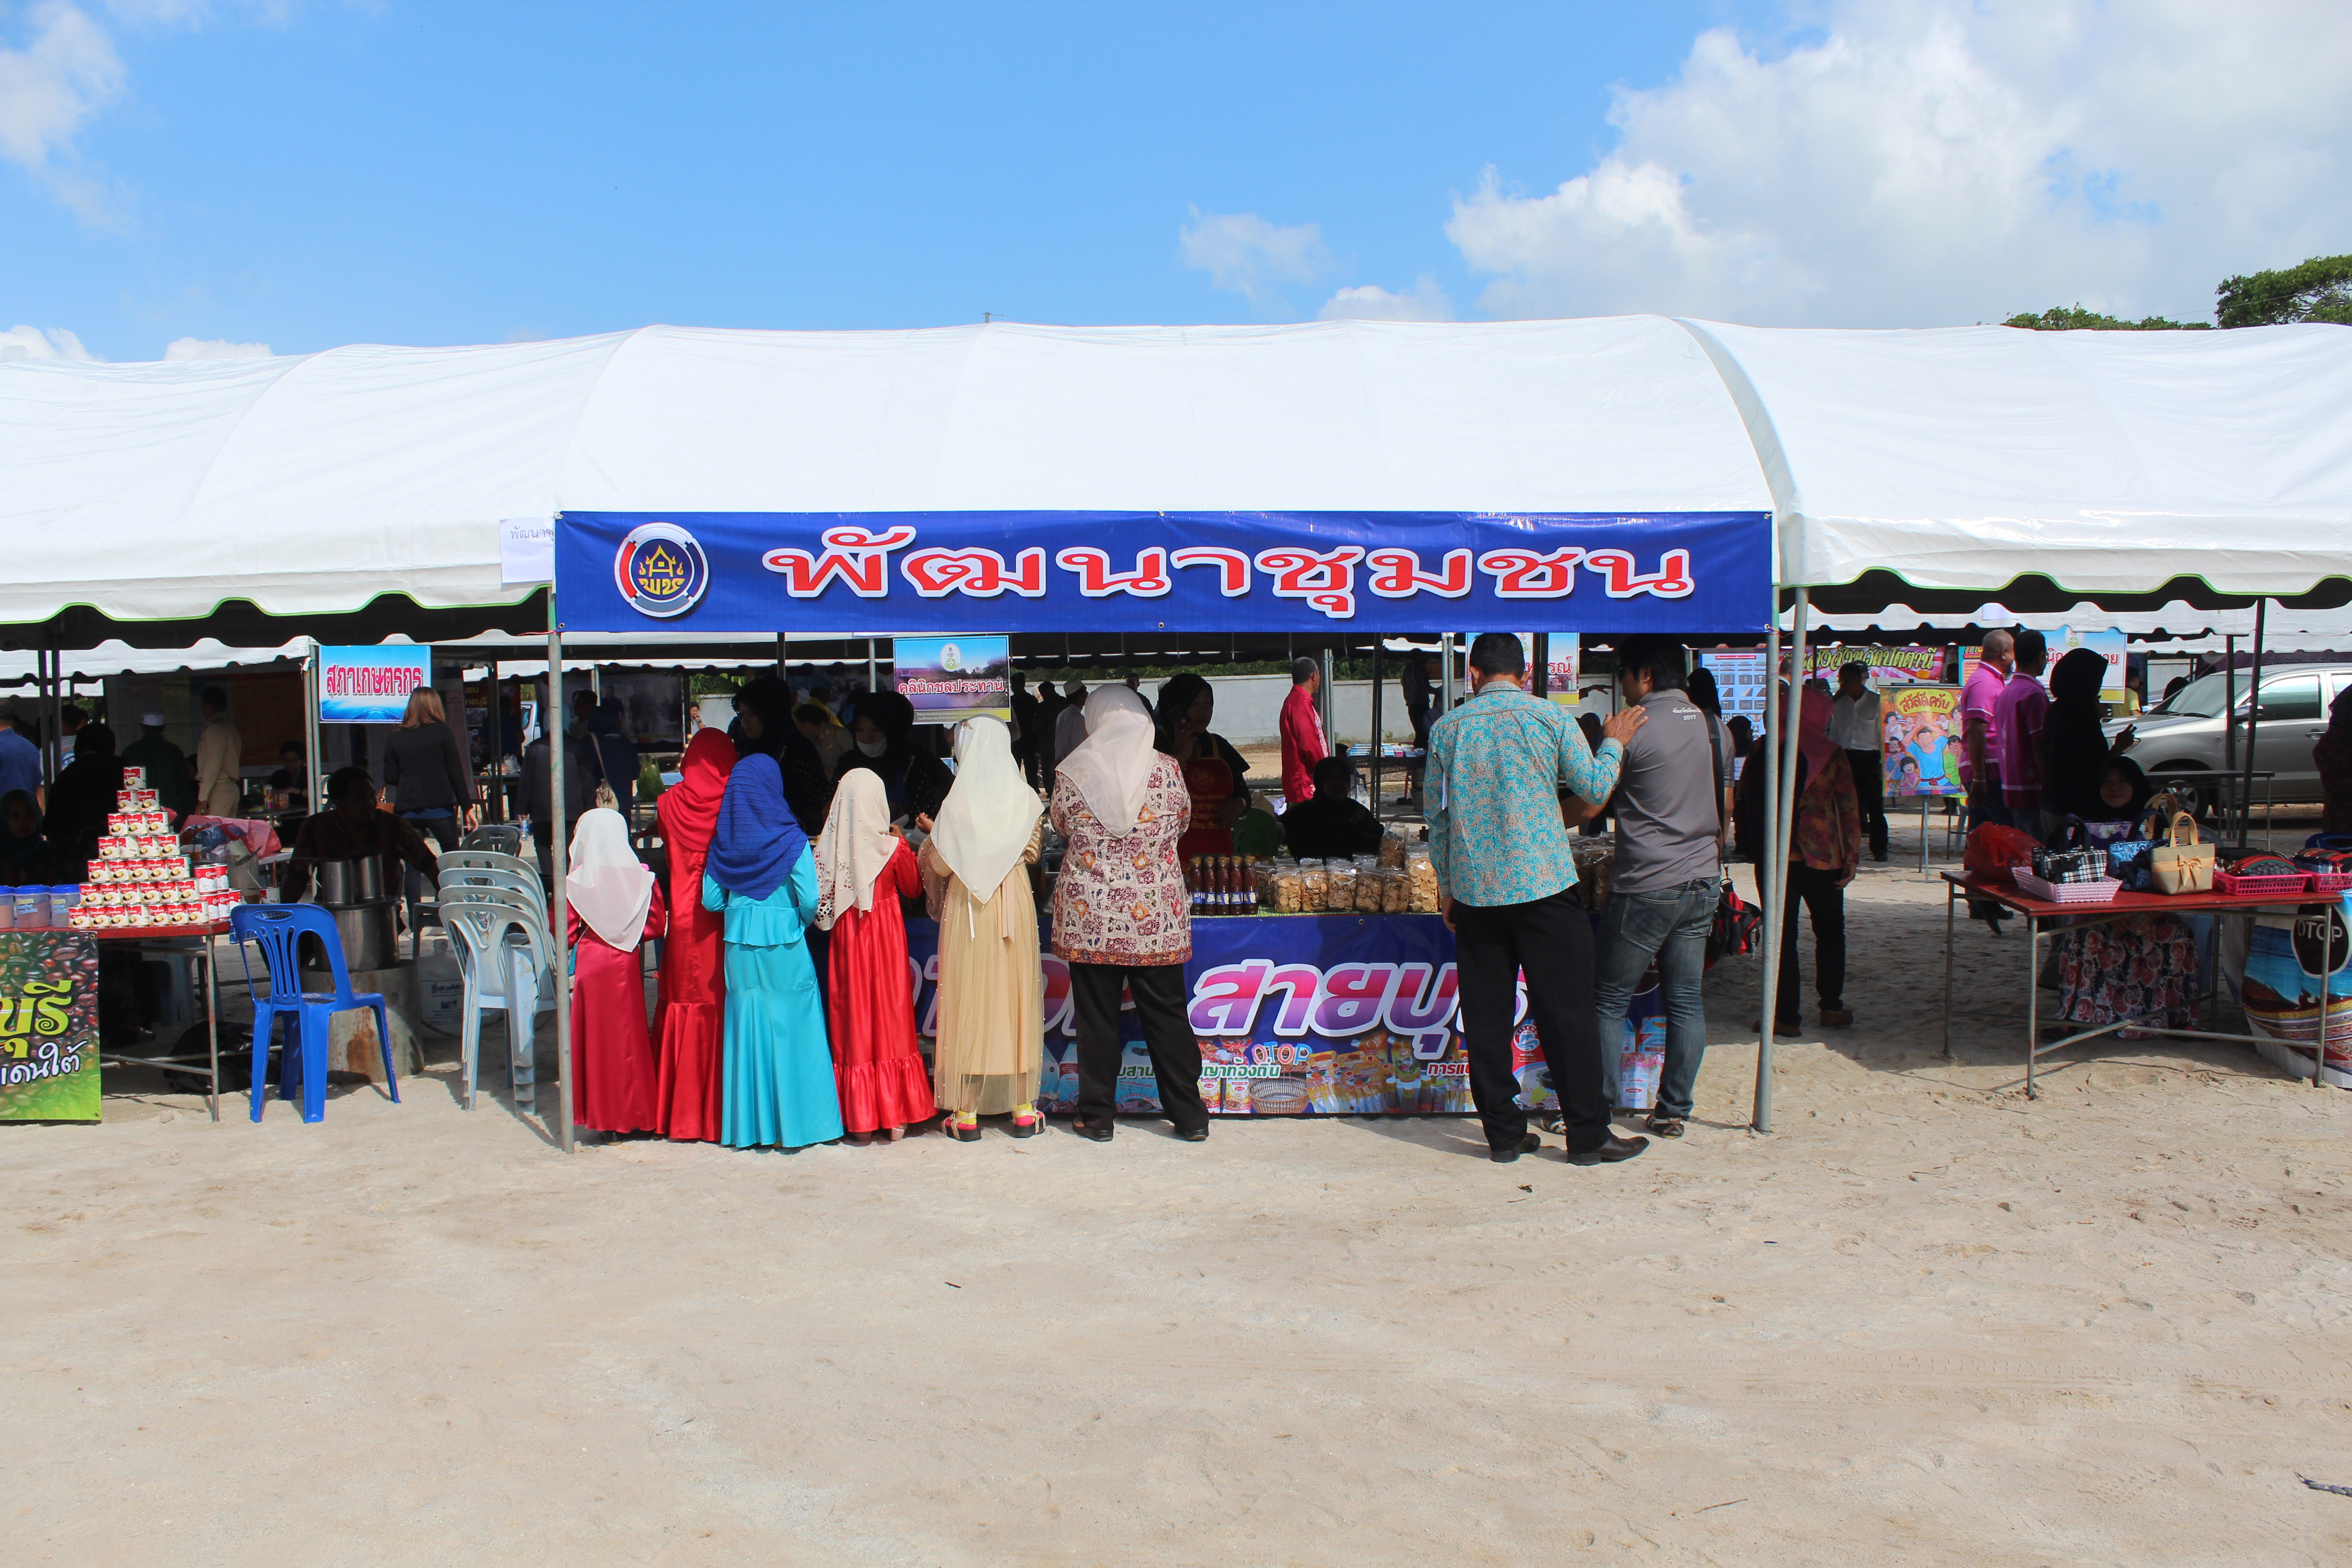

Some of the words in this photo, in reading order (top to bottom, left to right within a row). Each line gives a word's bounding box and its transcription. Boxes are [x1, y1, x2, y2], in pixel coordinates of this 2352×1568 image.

[764, 525, 1696, 619] พัฒนาชุมชน
[326, 664, 423, 697] สภาเกษตรกร
[898, 677, 1004, 695] คลินิกชลประทาน
[1899, 691, 1951, 712] สวัสดีครับ
[2297, 919, 2343, 943] OTOP
[1189, 960, 1528, 1059] สายบุ
[1251, 1041, 1313, 1066] OTOP
[1428, 1063, 1470, 1075] การแ
